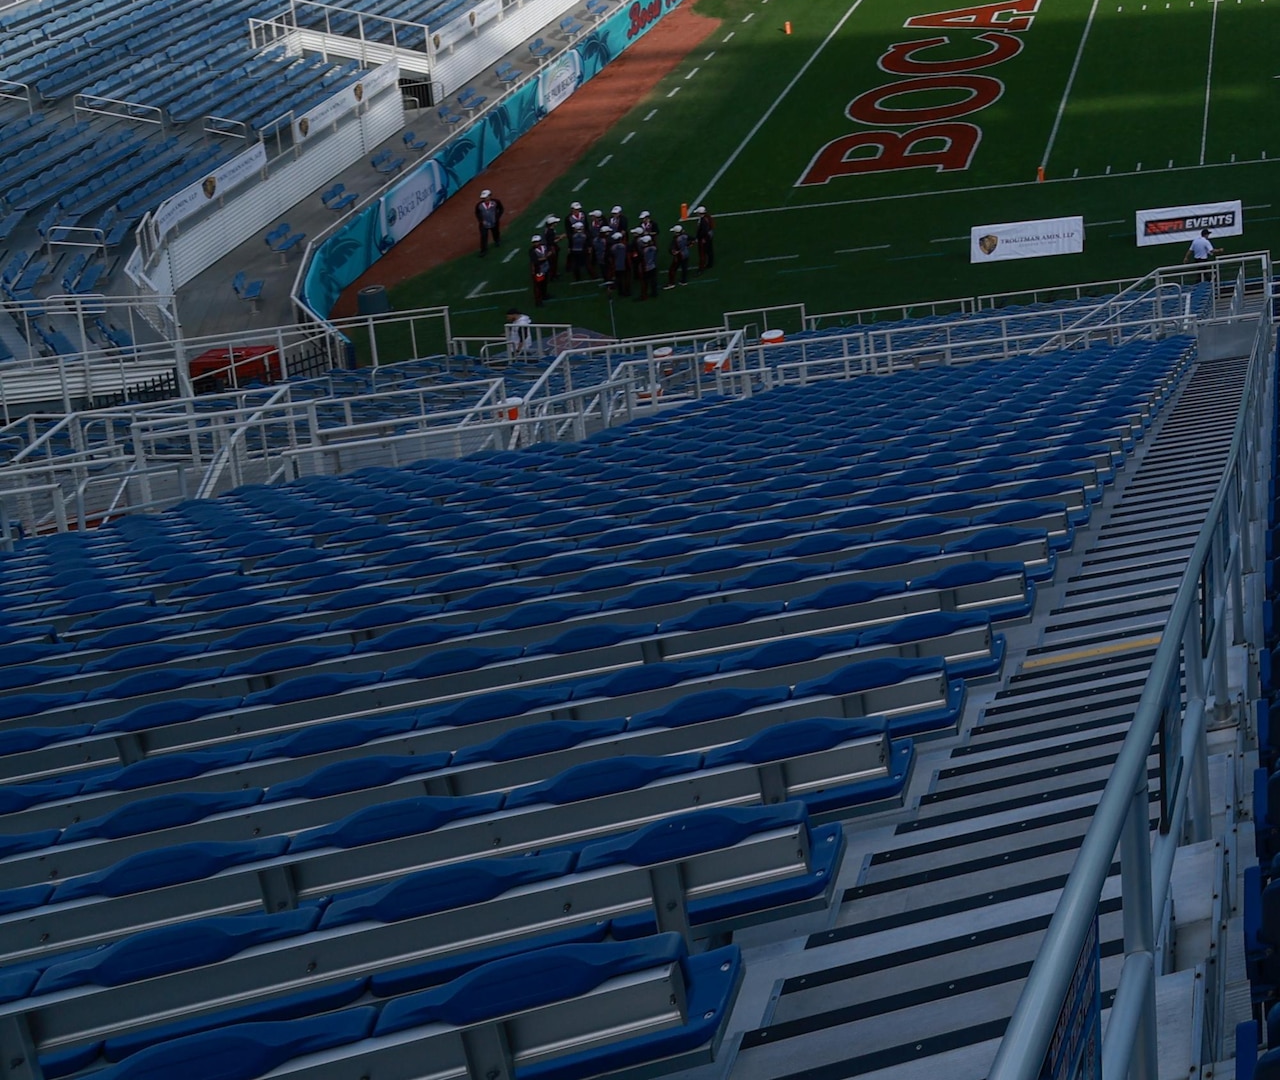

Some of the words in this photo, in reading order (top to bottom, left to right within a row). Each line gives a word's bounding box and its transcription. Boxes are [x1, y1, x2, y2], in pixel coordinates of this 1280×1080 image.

[398, 198, 416, 220] Boca
[1146, 221, 1184, 235] ESPN
[1185, 214, 1233, 230] EVENTS
[1001, 235, 1041, 245] TROUTMAN
[1042, 233, 1061, 242] AMIN,
[1062, 232, 1075, 240] LLP
